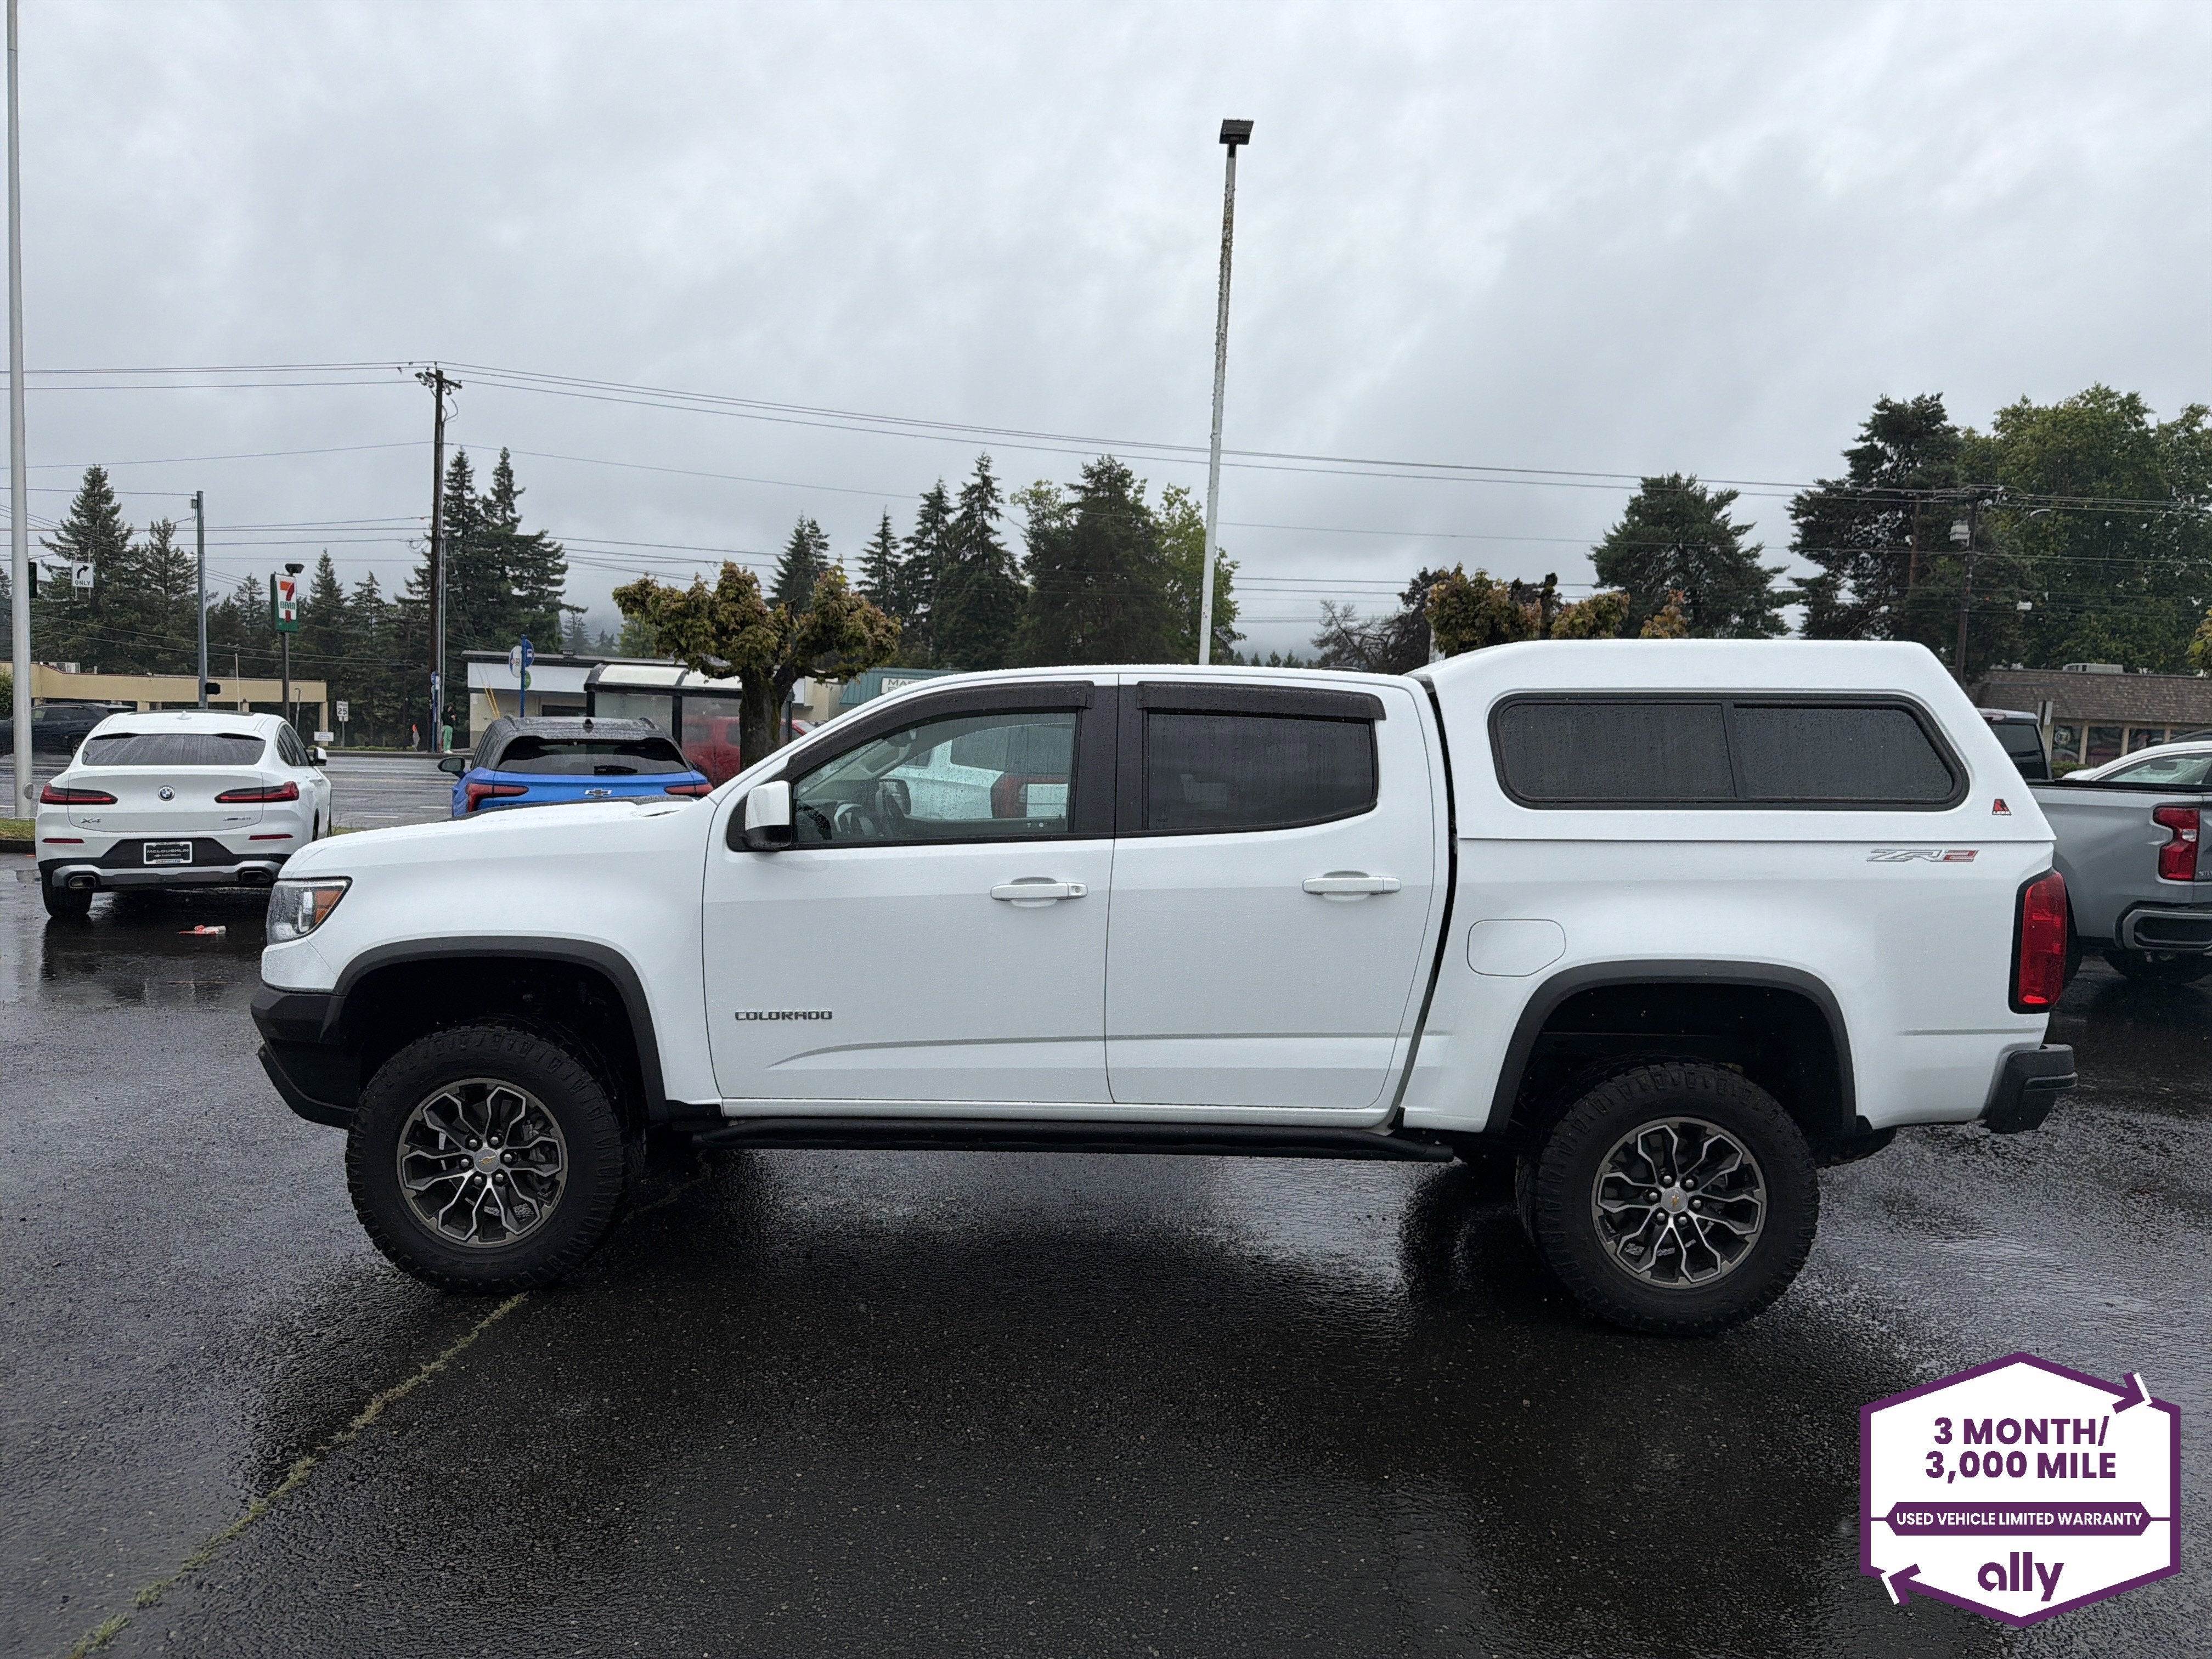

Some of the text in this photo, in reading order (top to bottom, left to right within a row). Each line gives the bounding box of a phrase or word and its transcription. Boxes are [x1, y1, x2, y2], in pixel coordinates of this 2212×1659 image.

[280, 580, 295, 623] 7
[338, 707, 347, 715] 25
[1866, 849, 1979, 862] ZR2
[735, 1011, 833, 1020] COLORADO
